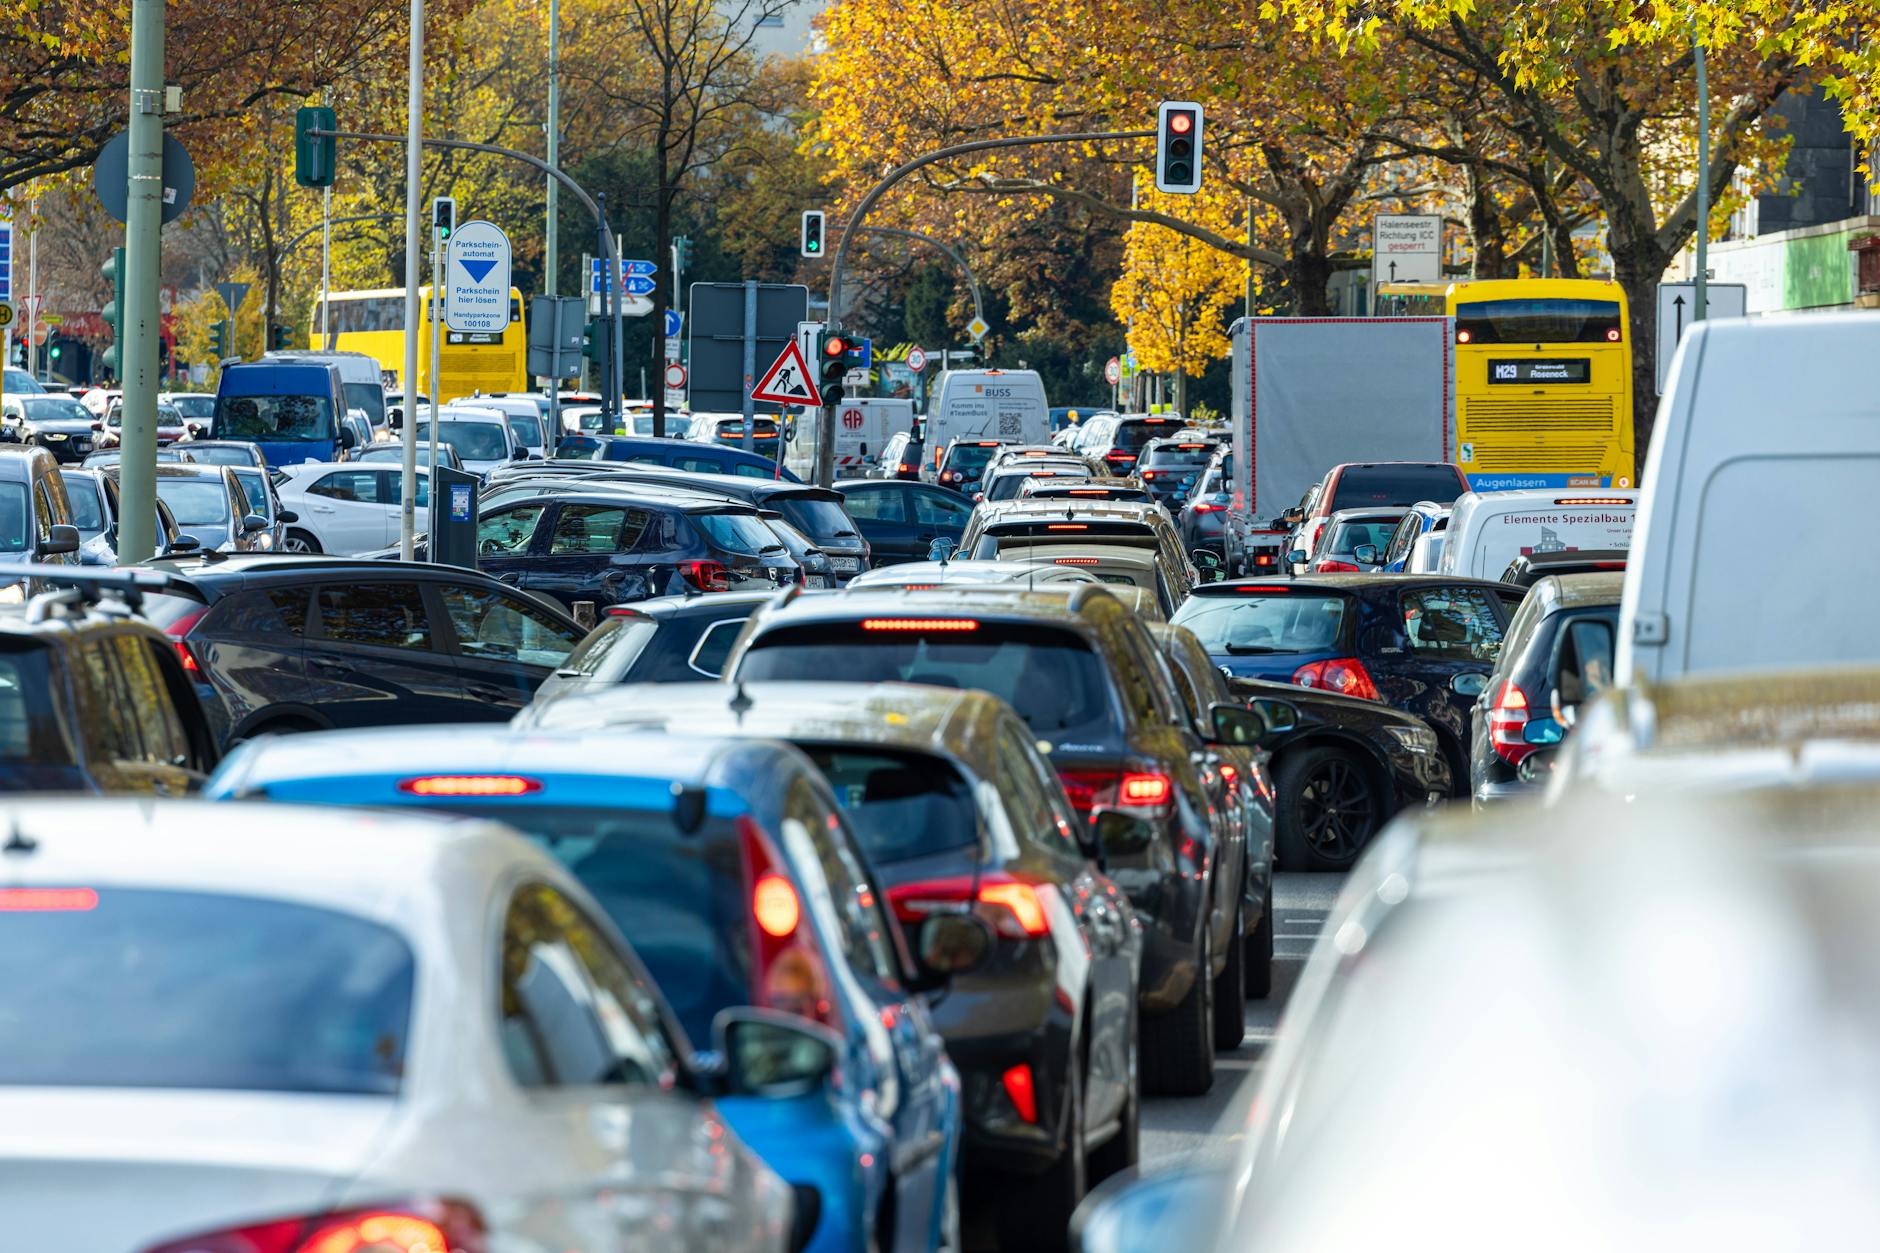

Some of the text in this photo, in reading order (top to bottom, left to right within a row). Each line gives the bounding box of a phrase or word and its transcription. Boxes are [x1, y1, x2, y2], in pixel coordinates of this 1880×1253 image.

[1380, 231, 1435, 242] Richtung ICC
[455, 240, 503, 249] Parkschein-
[1388, 243, 1425, 253] gesperrt
[456, 286, 500, 296] Parkschein
[458, 296, 497, 305] hier lösen
[453, 311, 501, 320] Handyparkzone
[464, 320, 491, 328] 100108
[1495, 364, 1517, 379] M29
[1530, 370, 1569, 379] Roseneck
[985, 388, 1012, 397] BUSS
[1475, 478, 1547, 489] Augenlasern
[1503, 514, 1558, 525] Elemente
[1562, 513, 1627, 526] Spezialbau
